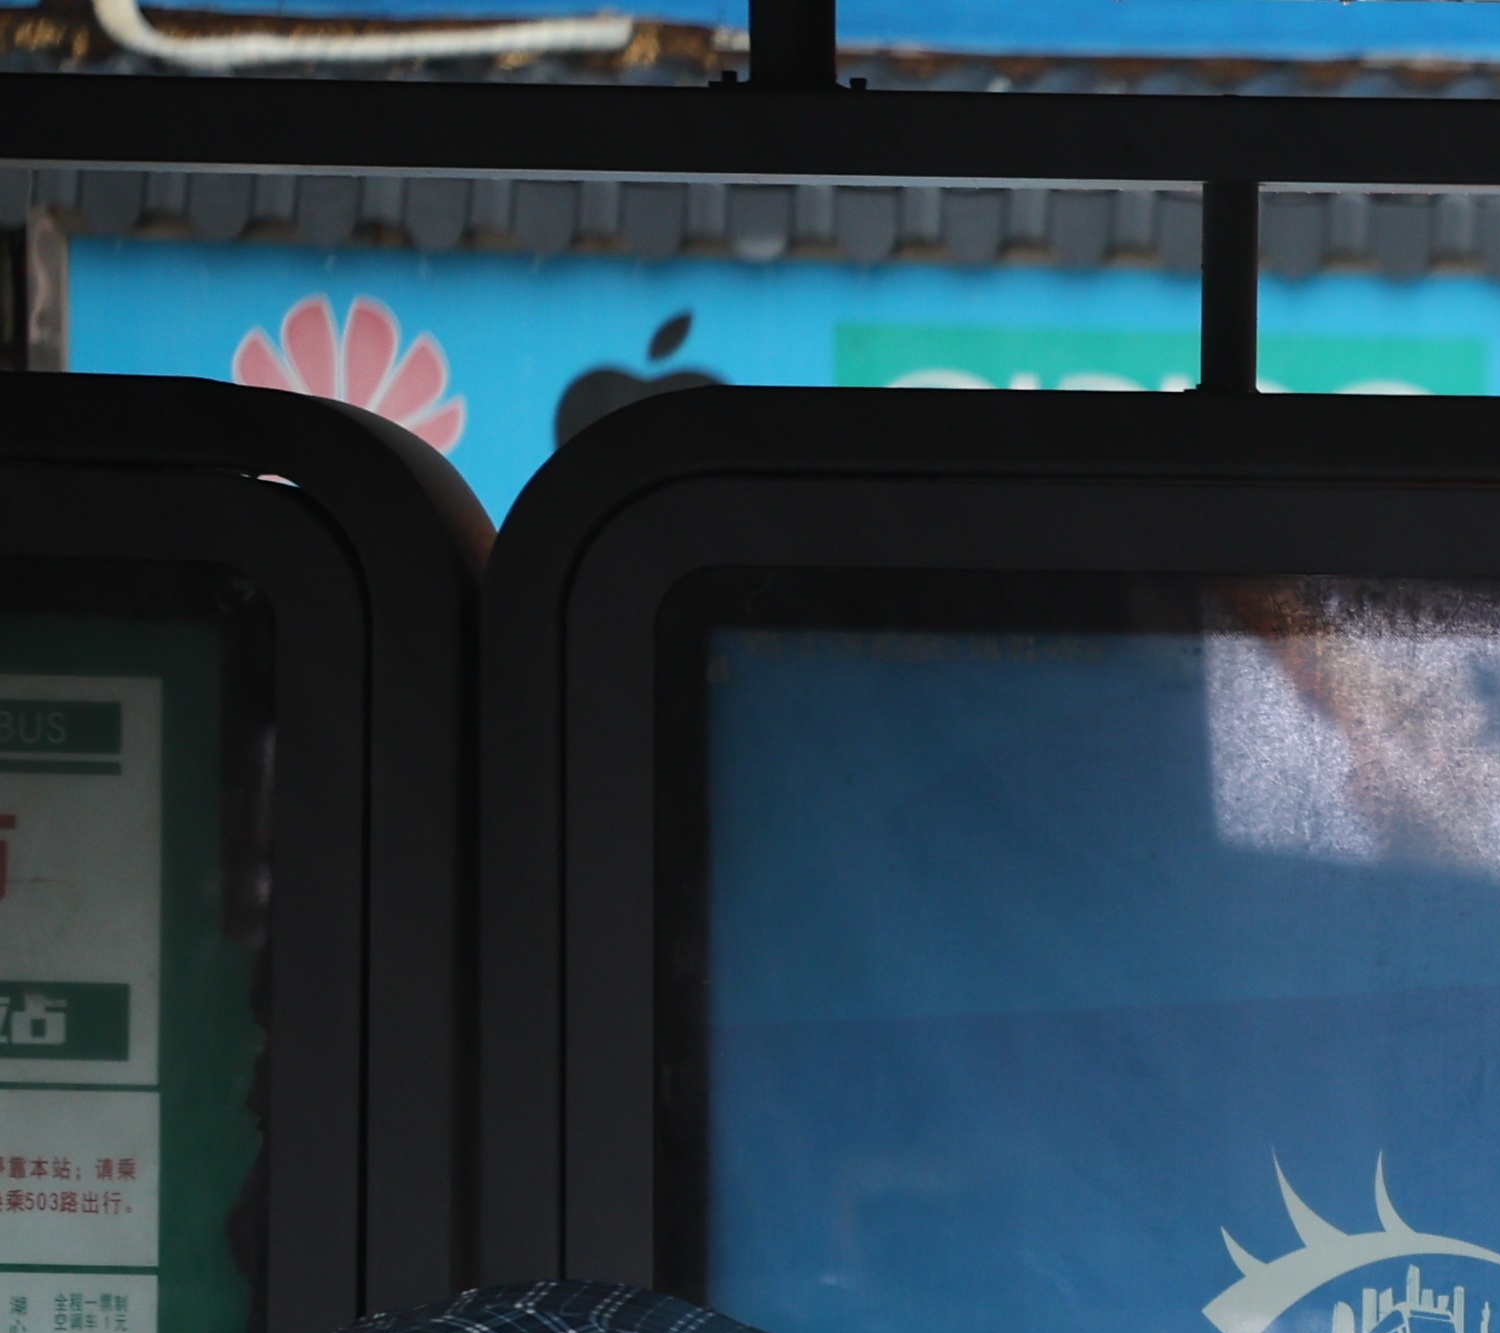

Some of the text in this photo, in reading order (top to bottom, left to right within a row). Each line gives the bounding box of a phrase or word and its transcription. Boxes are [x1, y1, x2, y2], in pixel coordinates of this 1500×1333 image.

[0, 1157, 136, 1181] 靠本站；请乘
[0, 1190, 133, 1215] 乘503路出行。
